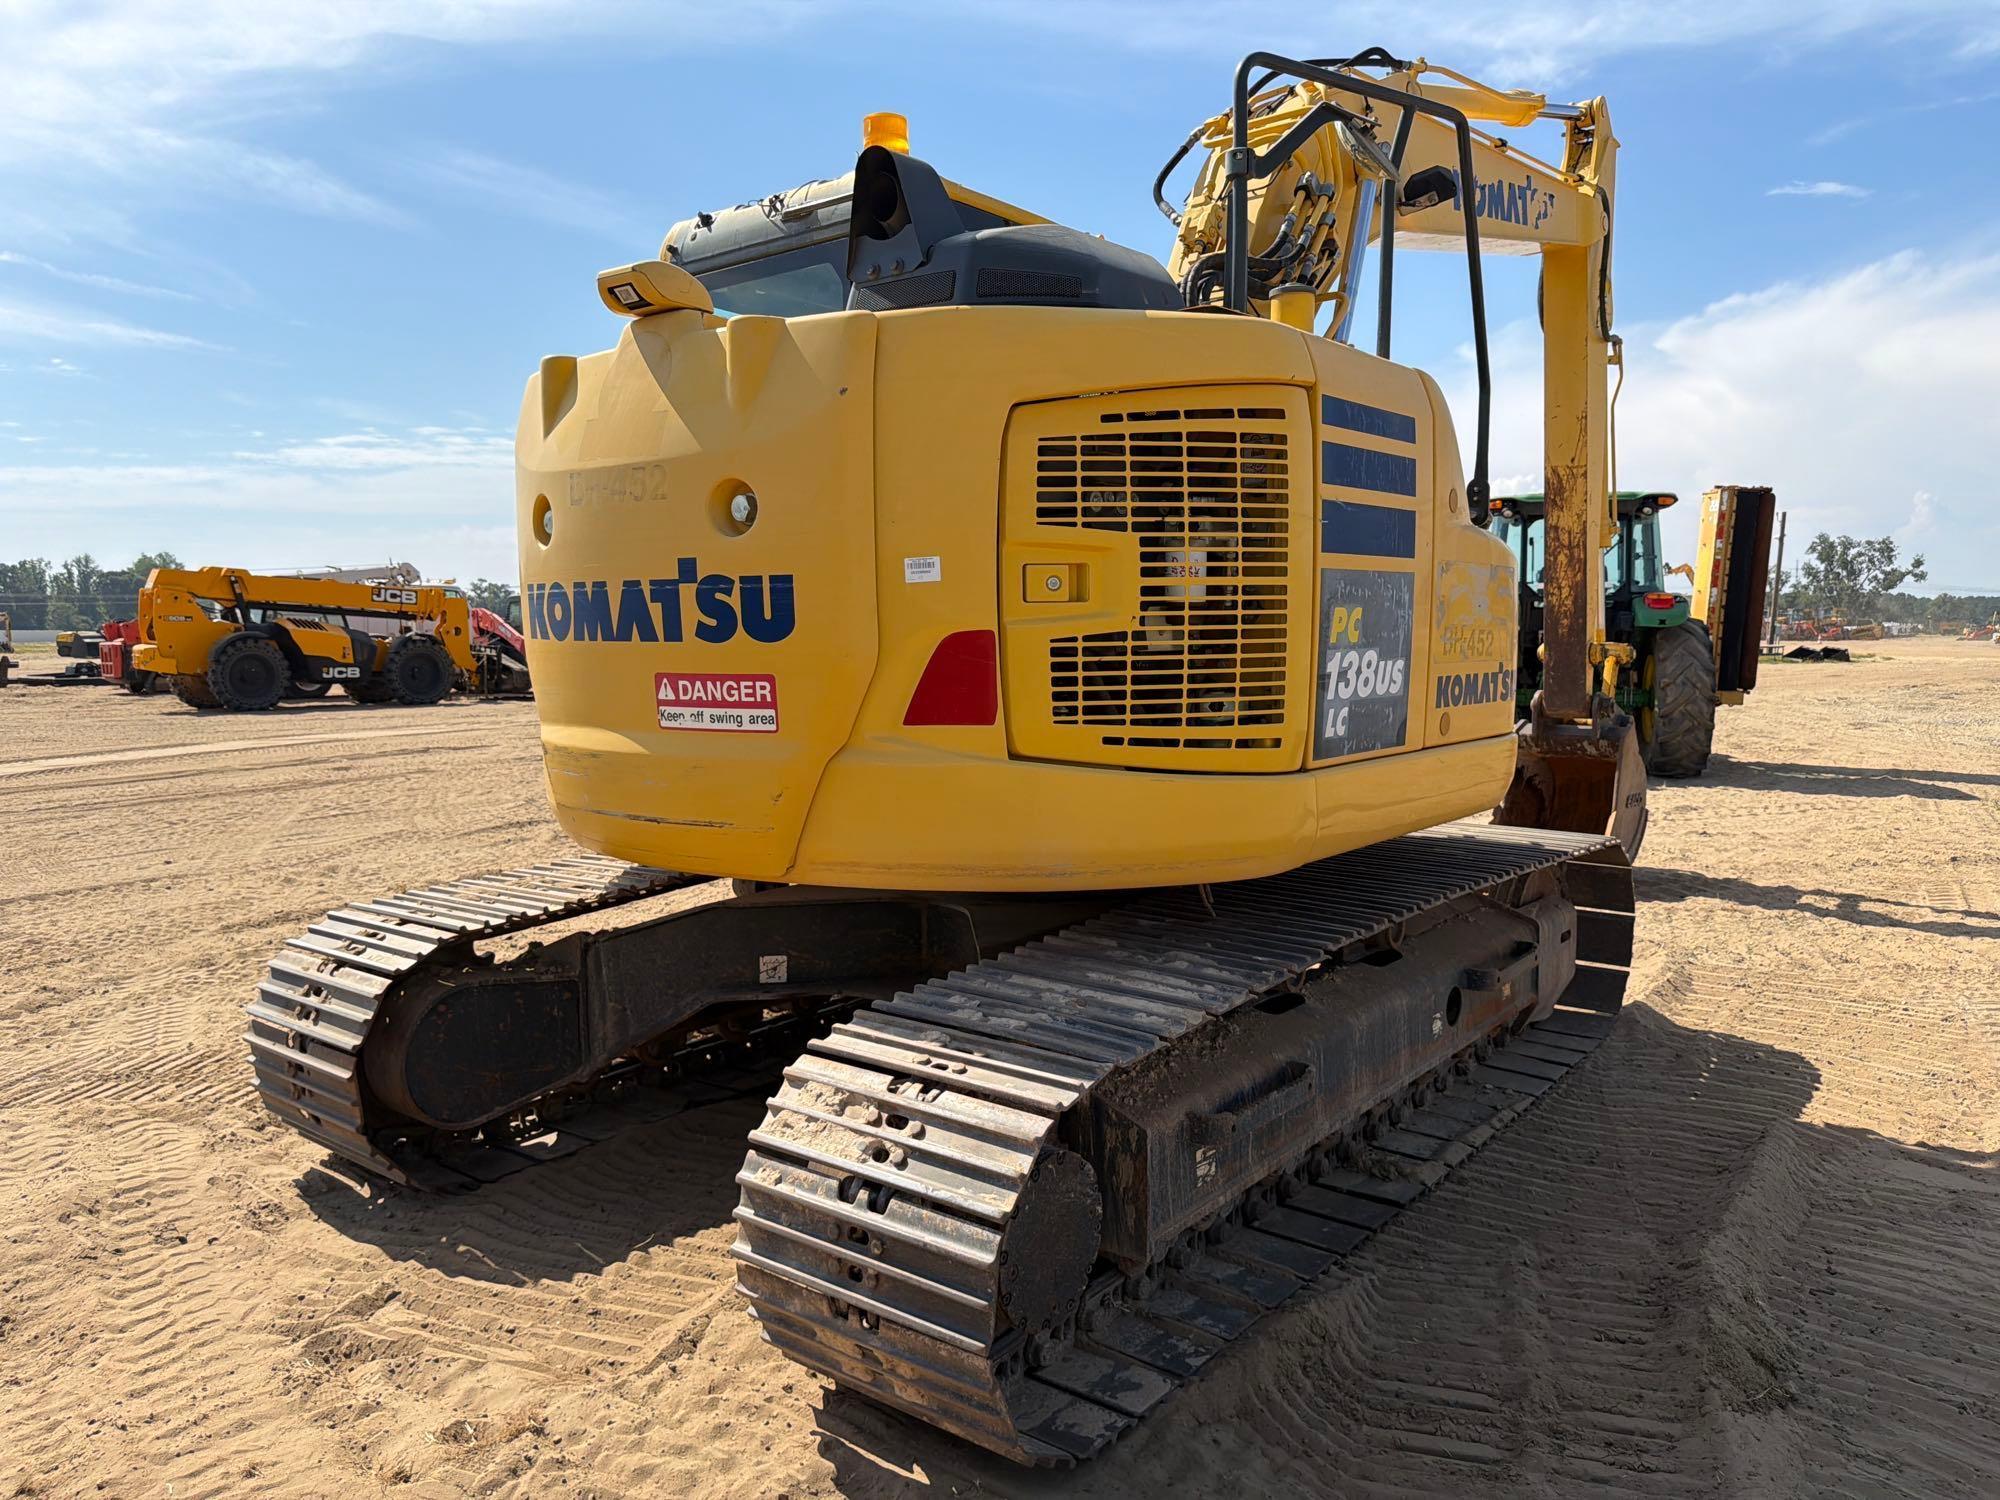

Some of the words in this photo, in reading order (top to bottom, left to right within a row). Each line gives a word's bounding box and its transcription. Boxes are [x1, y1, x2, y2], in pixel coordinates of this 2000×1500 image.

[372, 588, 417, 604] JCB
[527, 557, 796, 643] KOMATSU
[1329, 606, 1363, 644] PC
[322, 666, 360, 679] JCB
[677, 680, 772, 702] DANGER
[660, 709, 685, 726] Keep
[689, 710, 704, 723] off
[709, 711, 743, 728] swing
[748, 714, 775, 725] area
[1325, 706, 1349, 738] LC
